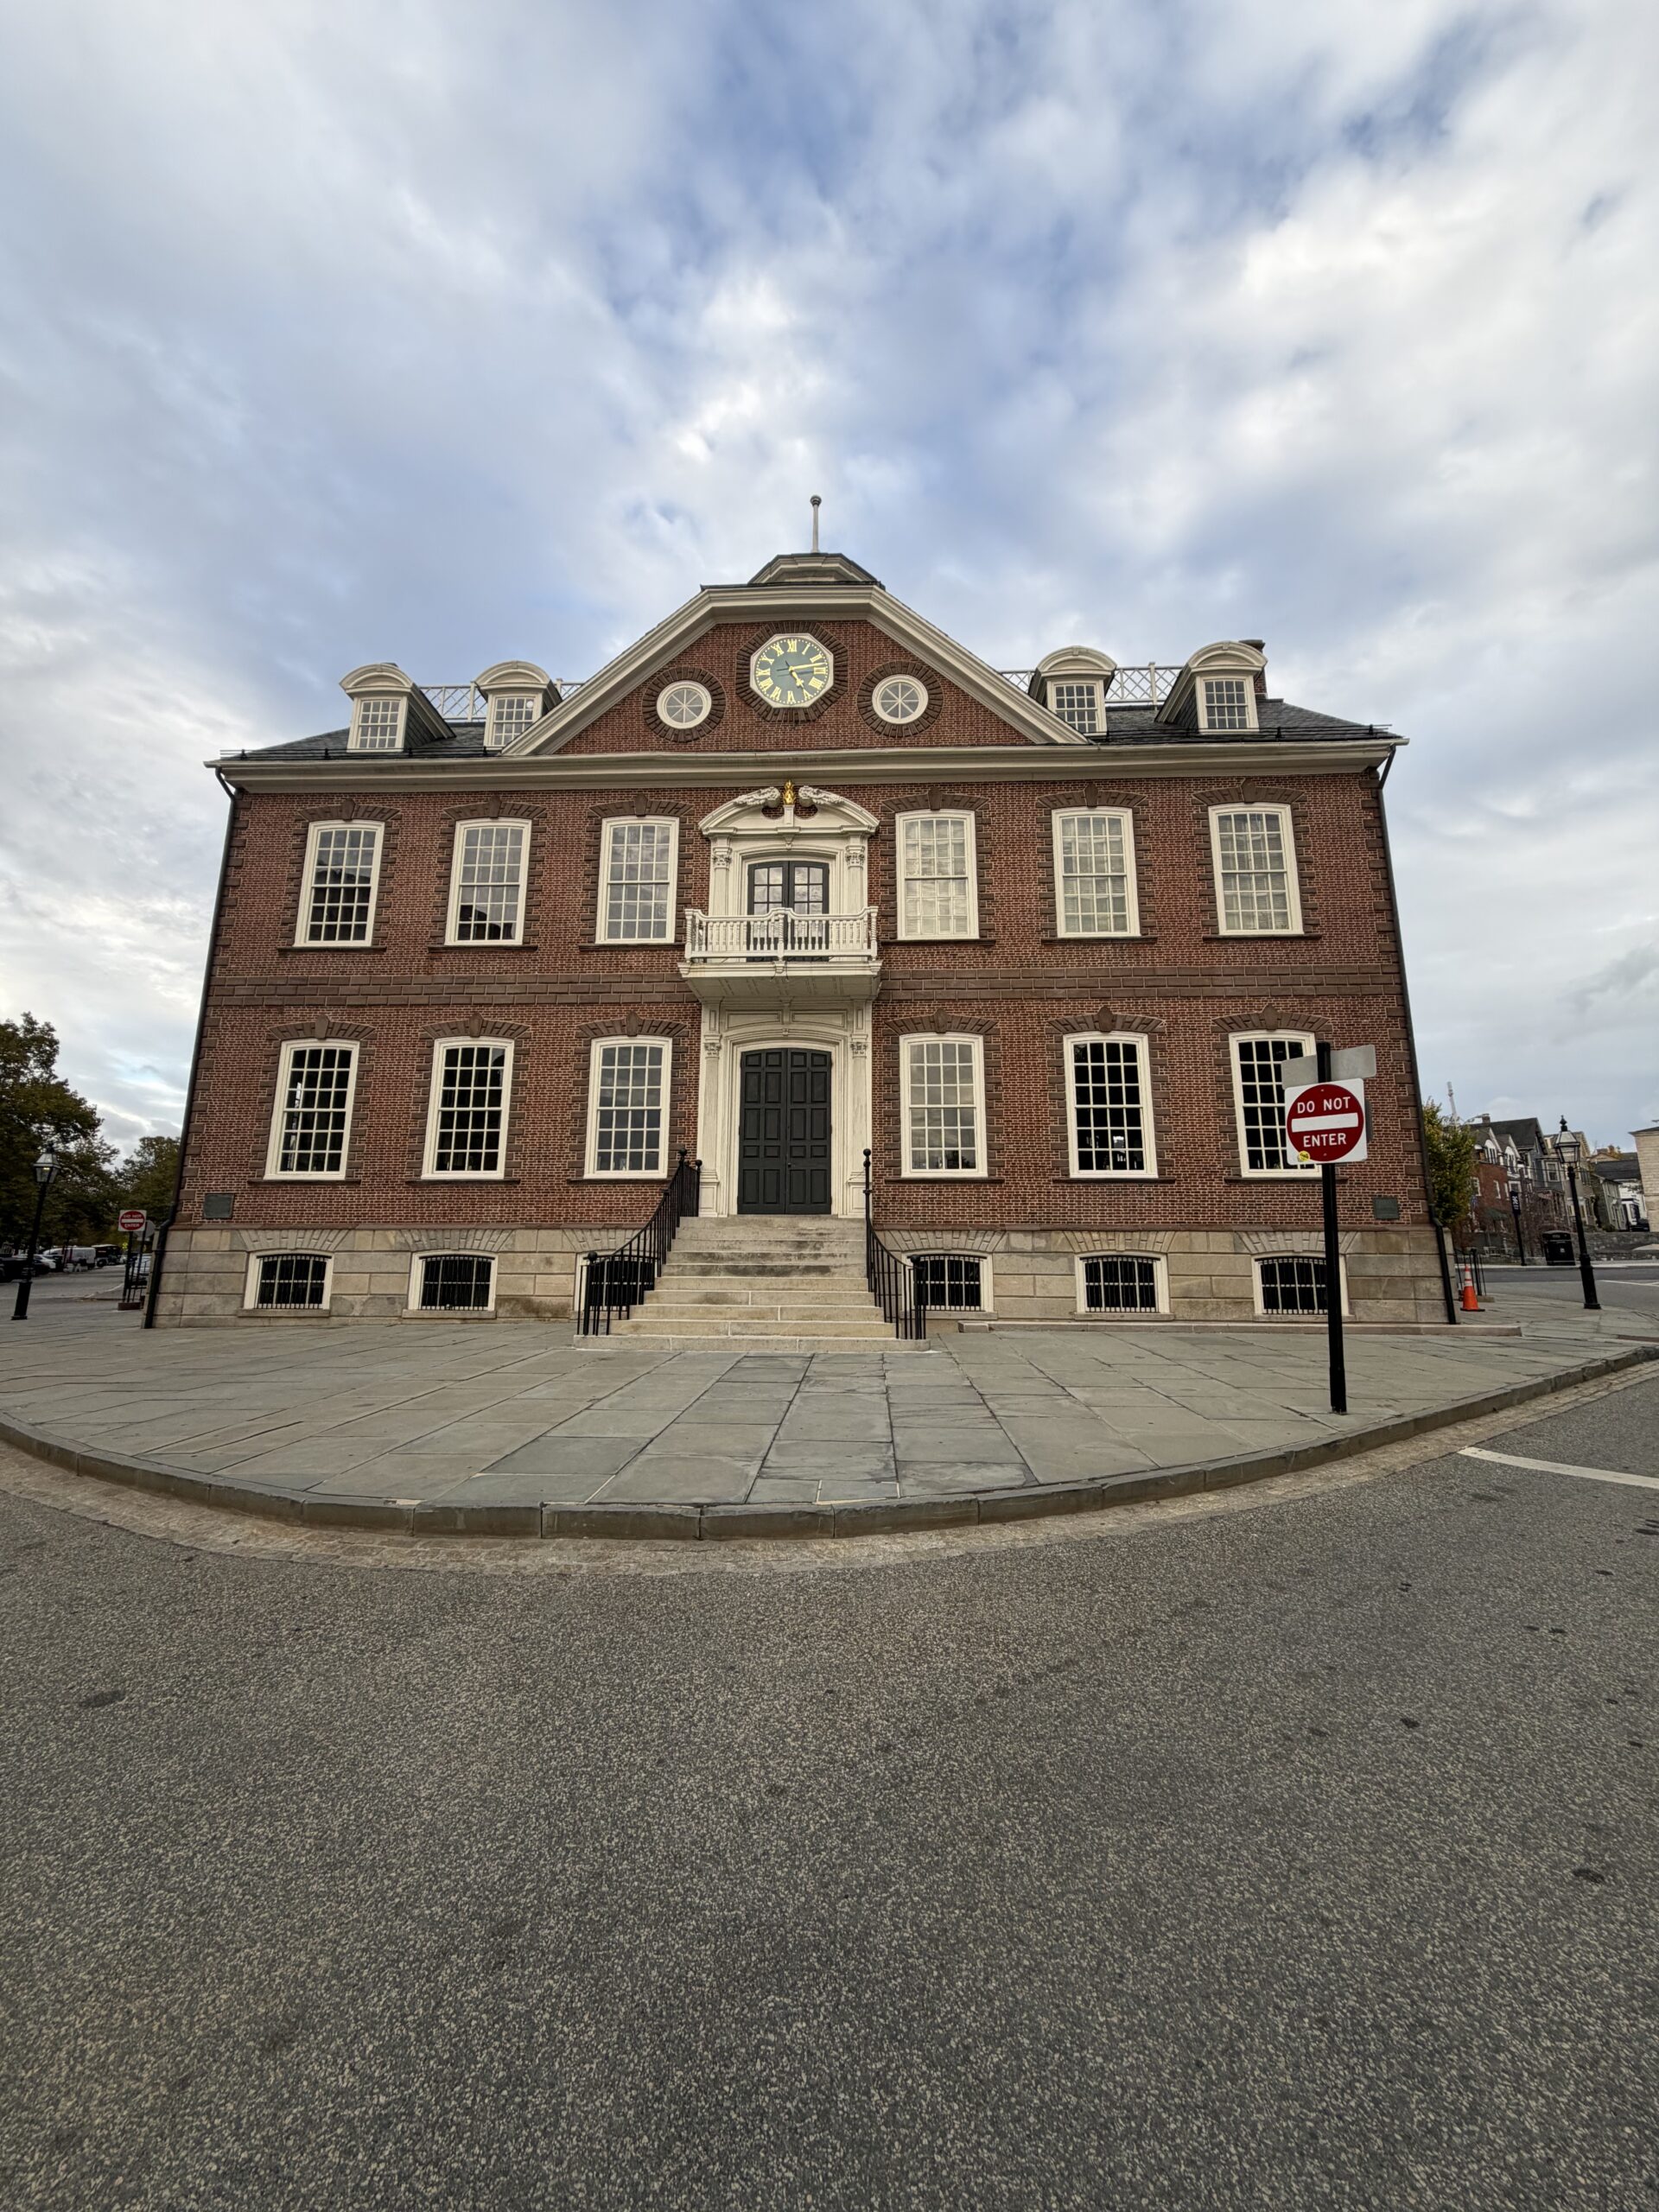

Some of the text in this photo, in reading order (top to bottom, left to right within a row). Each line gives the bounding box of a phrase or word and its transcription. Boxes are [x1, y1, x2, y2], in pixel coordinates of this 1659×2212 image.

[760, 654, 774, 665] X
[1297, 1096, 1351, 1114] DO NOT
[1303, 1133, 1347, 1147] ENTER
